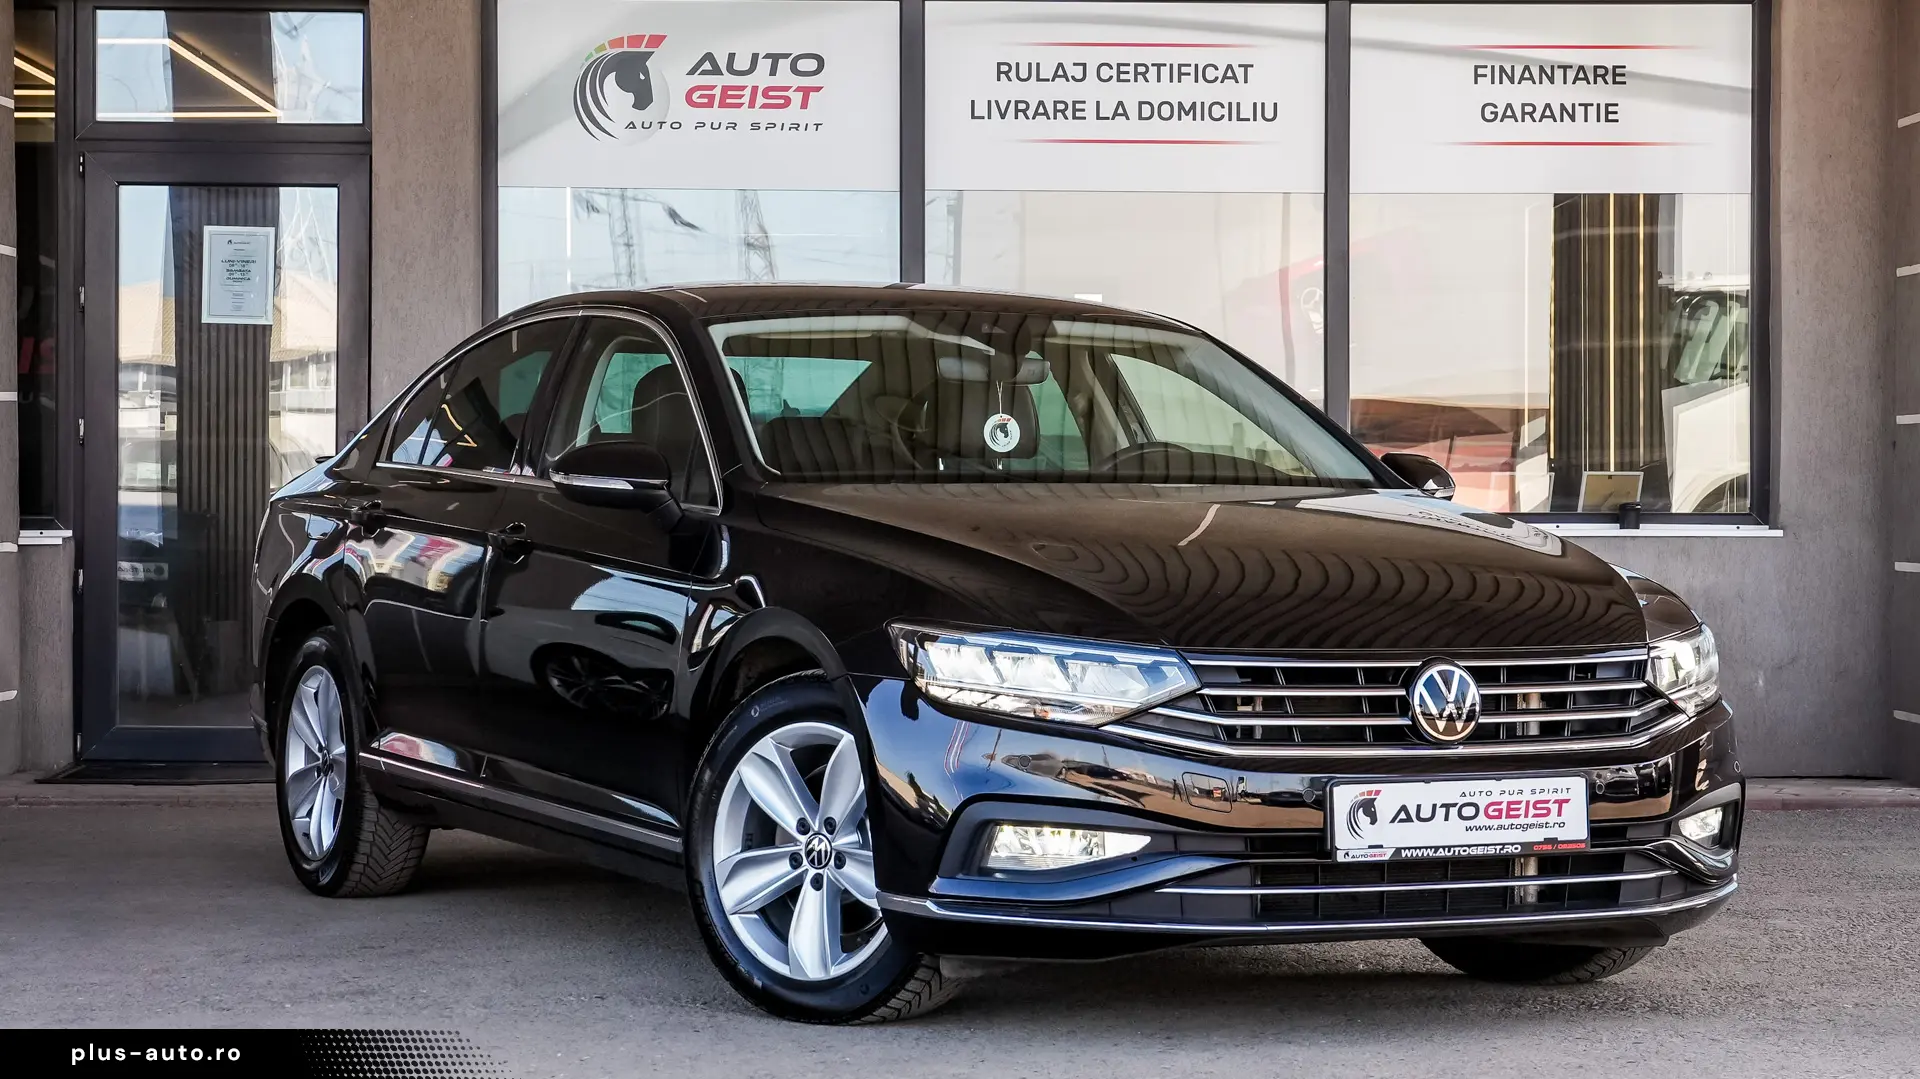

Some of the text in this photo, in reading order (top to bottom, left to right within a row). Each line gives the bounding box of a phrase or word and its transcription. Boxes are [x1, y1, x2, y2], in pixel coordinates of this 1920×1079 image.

[685, 51, 826, 77] AUTO
[996, 61, 1255, 84] RULAJ CERTIFICAT
[1473, 64, 1627, 85] FINANTARE
[684, 84, 825, 110] GEIST
[970, 99, 1279, 122] LIVRARE LA DOMICILIU
[1480, 102, 1620, 123] GARANTIE
[624, 120, 824, 132] AUTO PUR SPIRIT
[1530, 787, 1572, 795] SPIRIT
[1465, 821, 1566, 832] www.autogeist.ro
[1401, 844, 1521, 858] WWW.AUTOGEIST.RO
